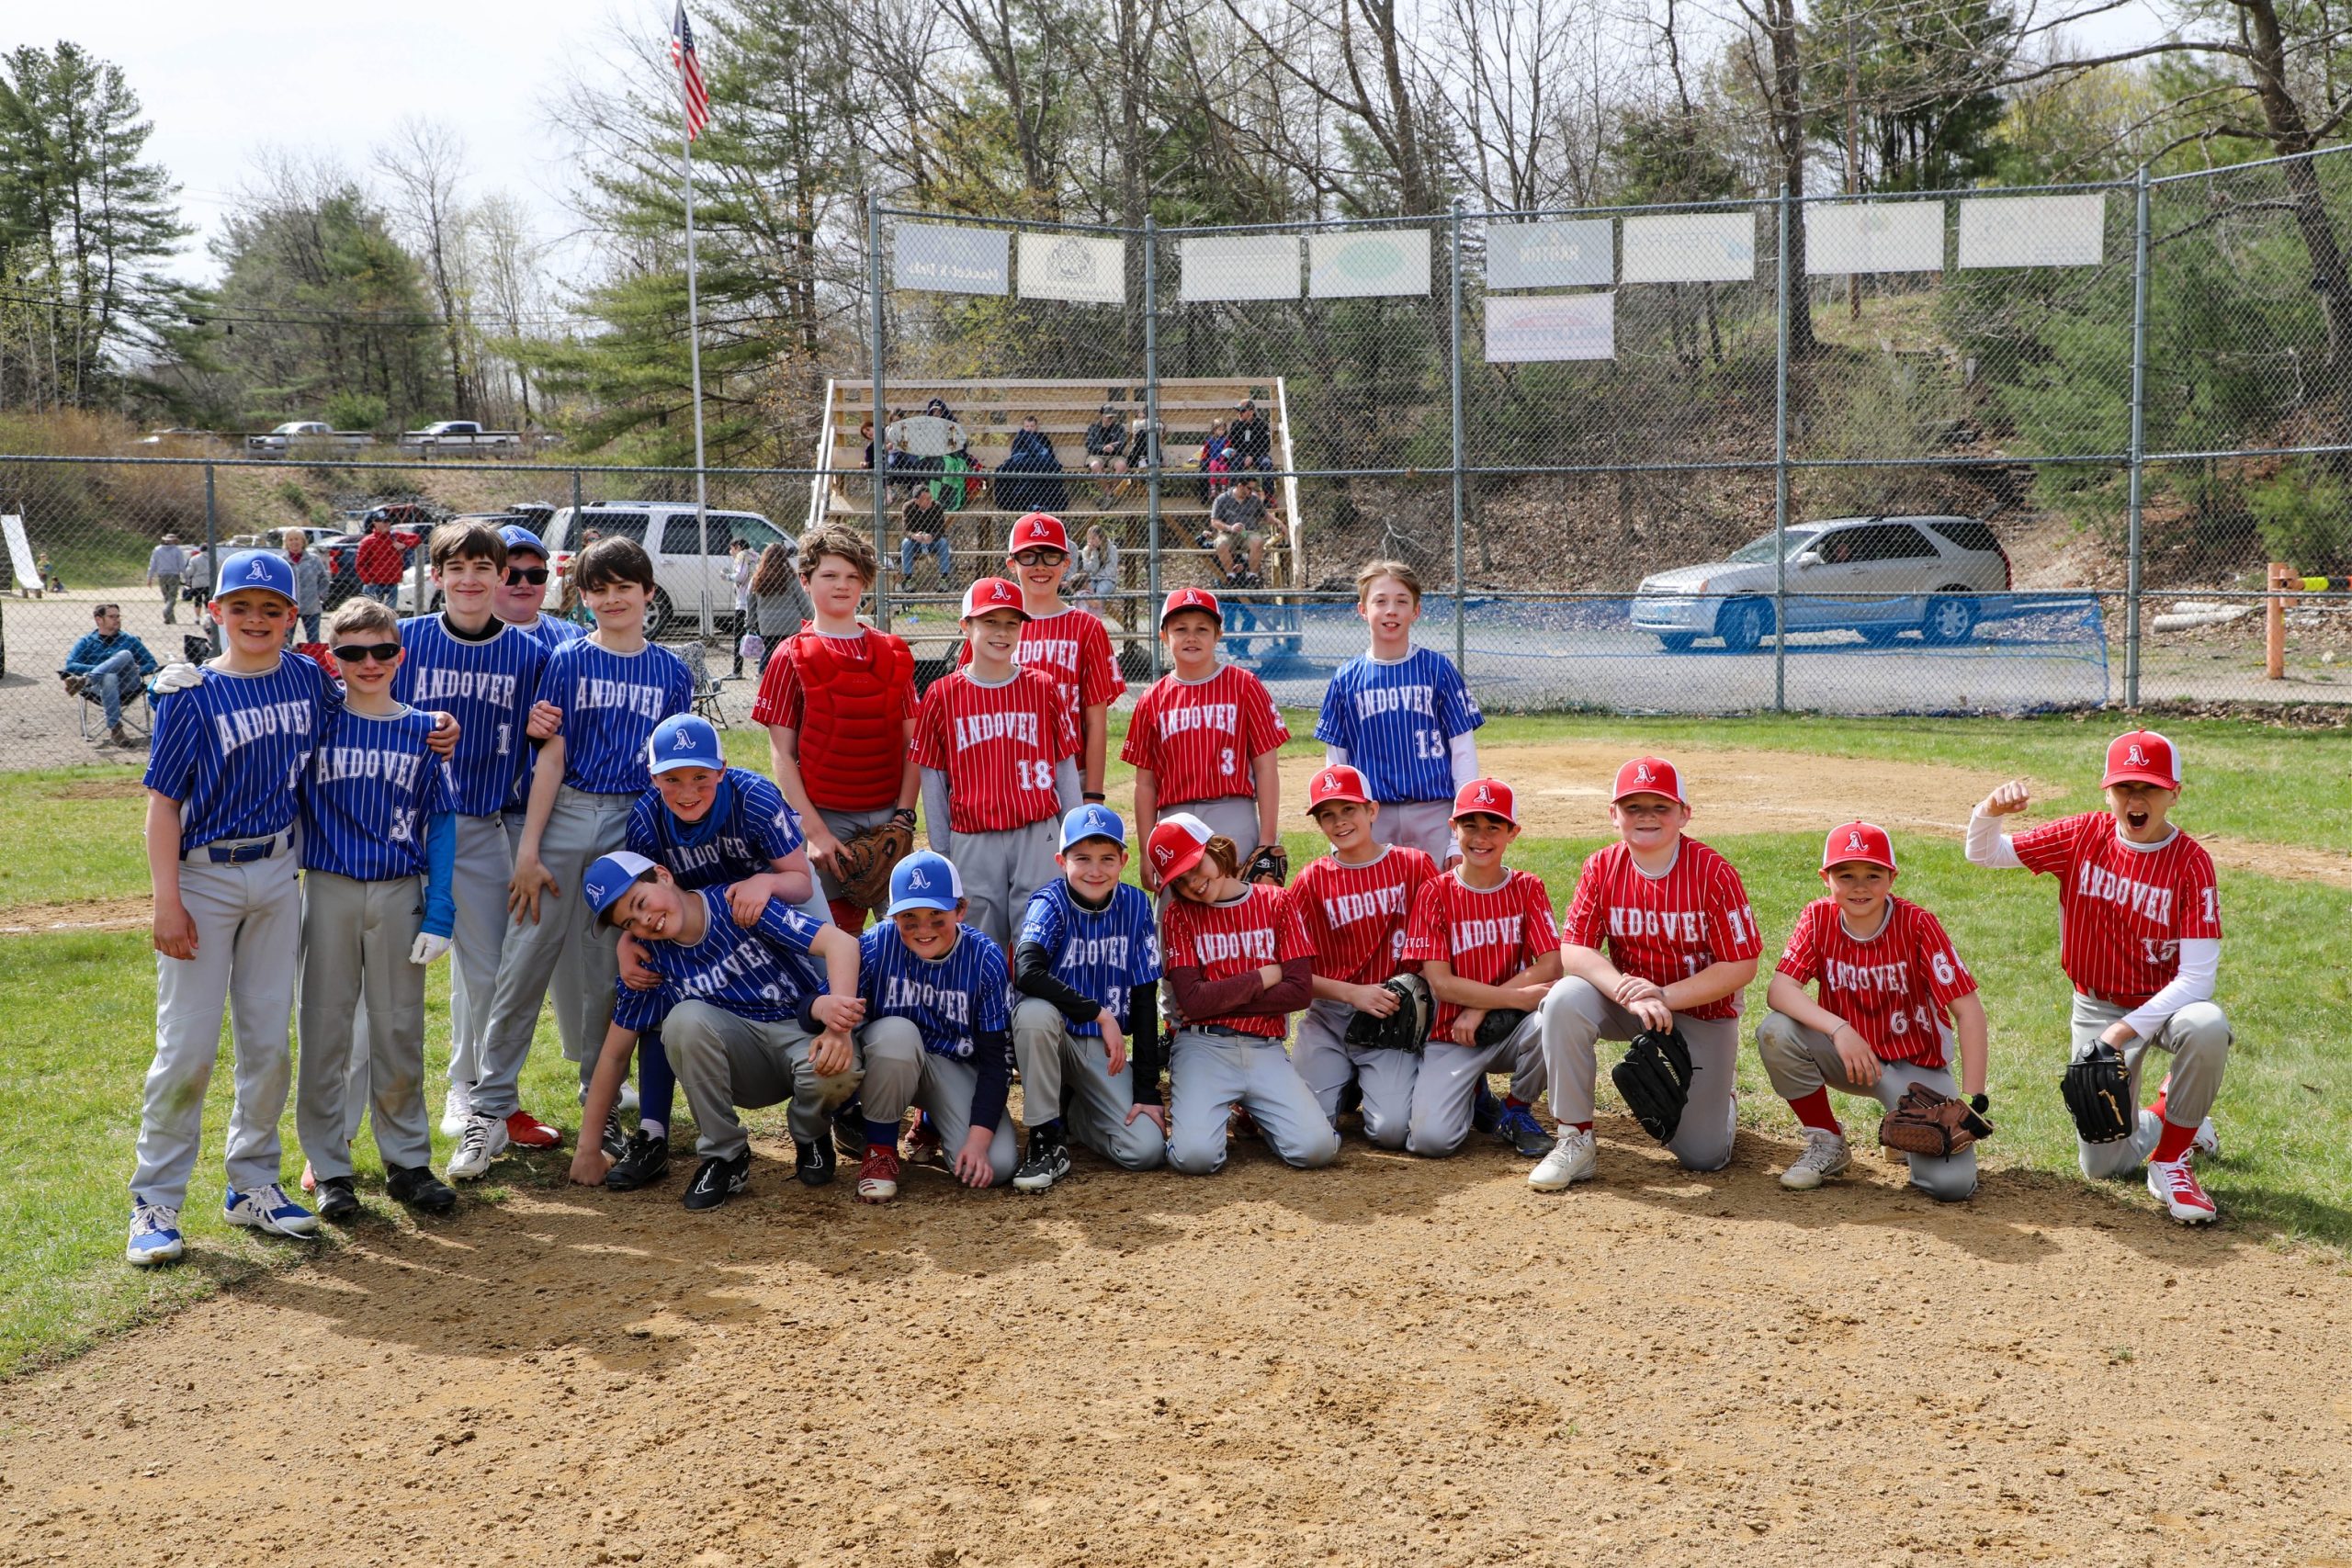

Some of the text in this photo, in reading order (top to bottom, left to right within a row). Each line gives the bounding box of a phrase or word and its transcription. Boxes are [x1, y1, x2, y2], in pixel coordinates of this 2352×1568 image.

[1011, 639, 1079, 671] NDOVER
[413, 666, 515, 711] ANDOVER
[574, 676, 664, 721] ANDOVER
[496, 723, 513, 756] 1
[956, 712, 1039, 752] ANDOVER
[1159, 703, 1238, 743] ANDOVER
[1414, 728, 1446, 760] 13
[1016, 759, 1055, 790] 18
[1220, 747, 1236, 777] 3
[774, 809, 793, 841] 7
[2078, 860, 2173, 927] ANDOVER
[1195, 928, 1277, 966] ANDOVER
[1452, 913, 1524, 956] ANDOVE
[2141, 937, 2179, 964] 15
[883, 975, 969, 1025] ANDOVER
[1890, 1005, 1931, 1036] 64
[956, 1035, 975, 1058] 6
